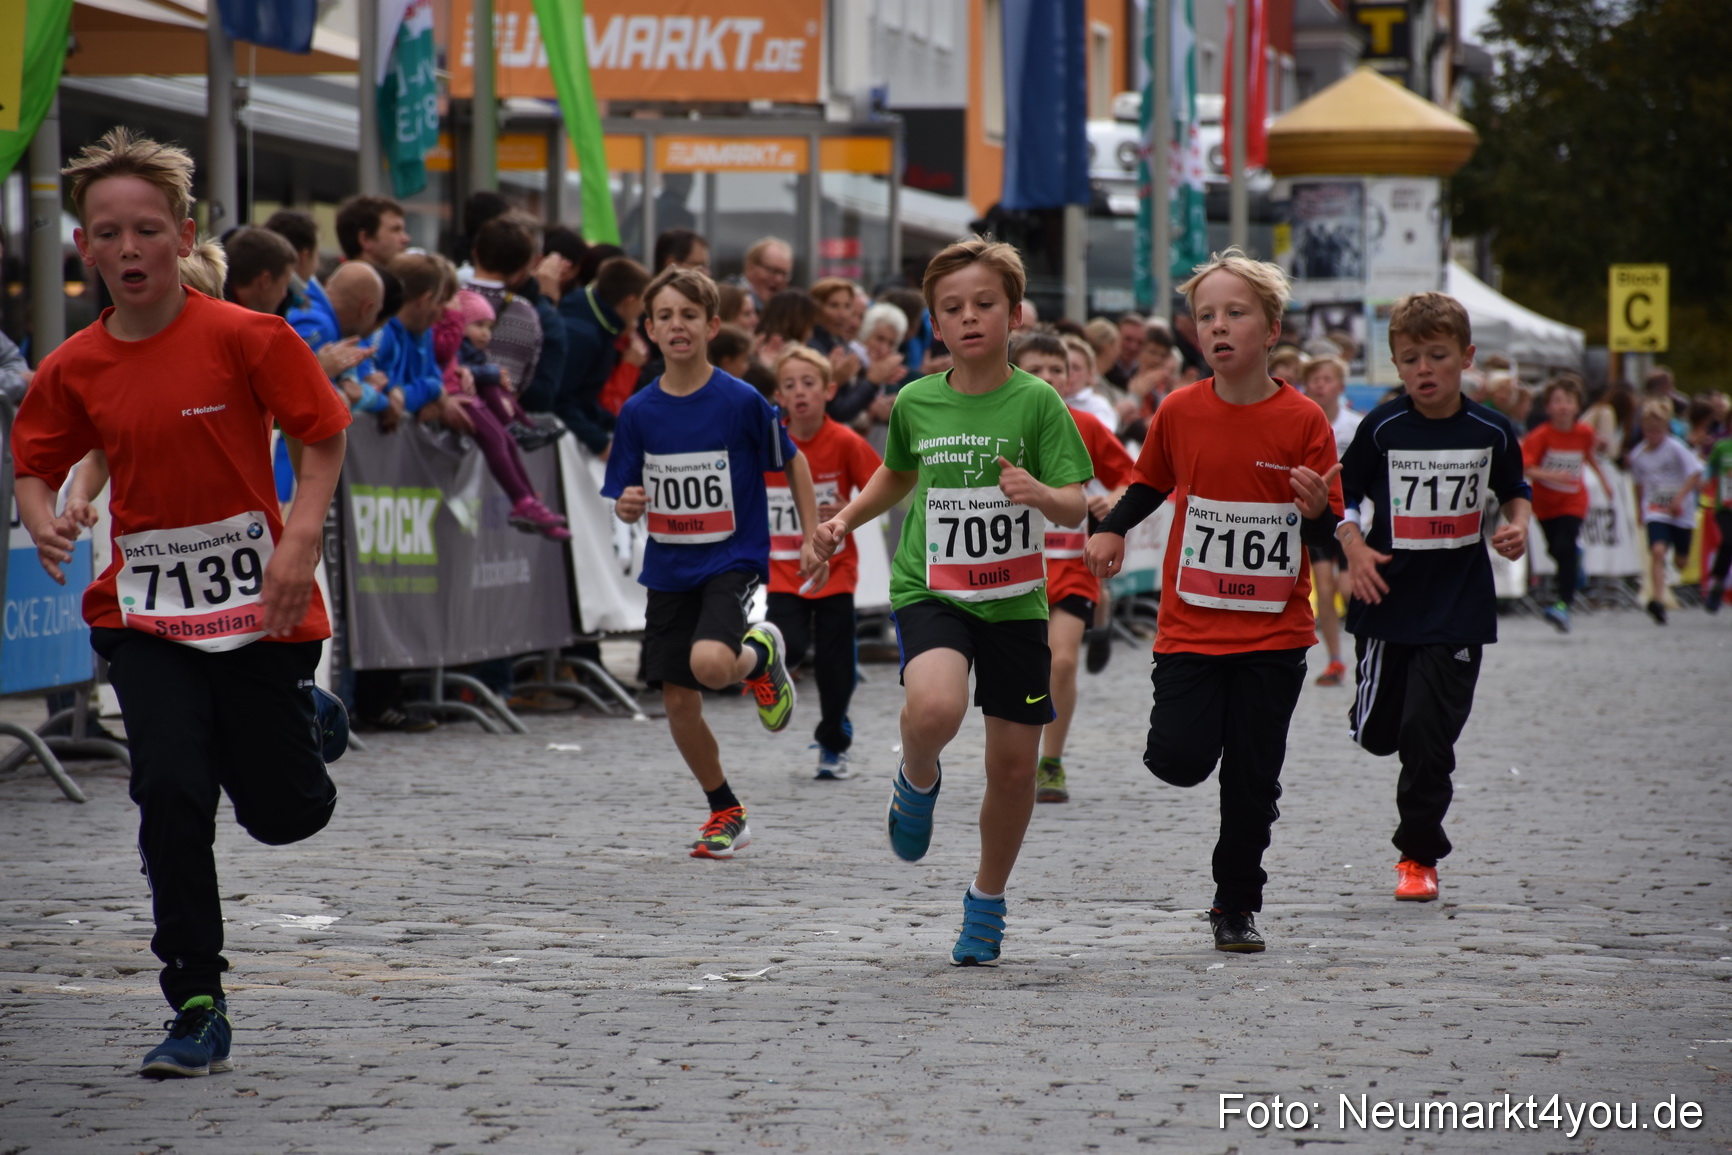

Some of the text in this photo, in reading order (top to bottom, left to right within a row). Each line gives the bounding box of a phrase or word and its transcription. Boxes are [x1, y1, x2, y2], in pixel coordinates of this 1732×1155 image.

[1358, 8, 1406, 54] T
[1623, 291, 1651, 333] C
[918, 433, 991, 450] Neumarkter
[665, 463, 711, 473] Neumarkt
[1392, 460, 1479, 470] PARTL Neumarkt
[649, 475, 723, 510] 7006
[1401, 473, 1479, 511] 7173
[929, 500, 1022, 510] PARTL Neuma
[1189, 507, 1282, 525] PARTL Neumarkt
[352, 495, 439, 555] BOCK
[667, 519, 704, 532] Moritz
[938, 510, 1030, 558] 7091
[1429, 521, 1455, 535] Tim
[168, 531, 242, 554] Neumarkt
[1195, 525, 1290, 570] 7164
[132, 547, 264, 611] 7139
[969, 568, 1010, 586] Louis
[1219, 579, 1255, 596] Luca
[155, 613, 256, 637] Sebastian
